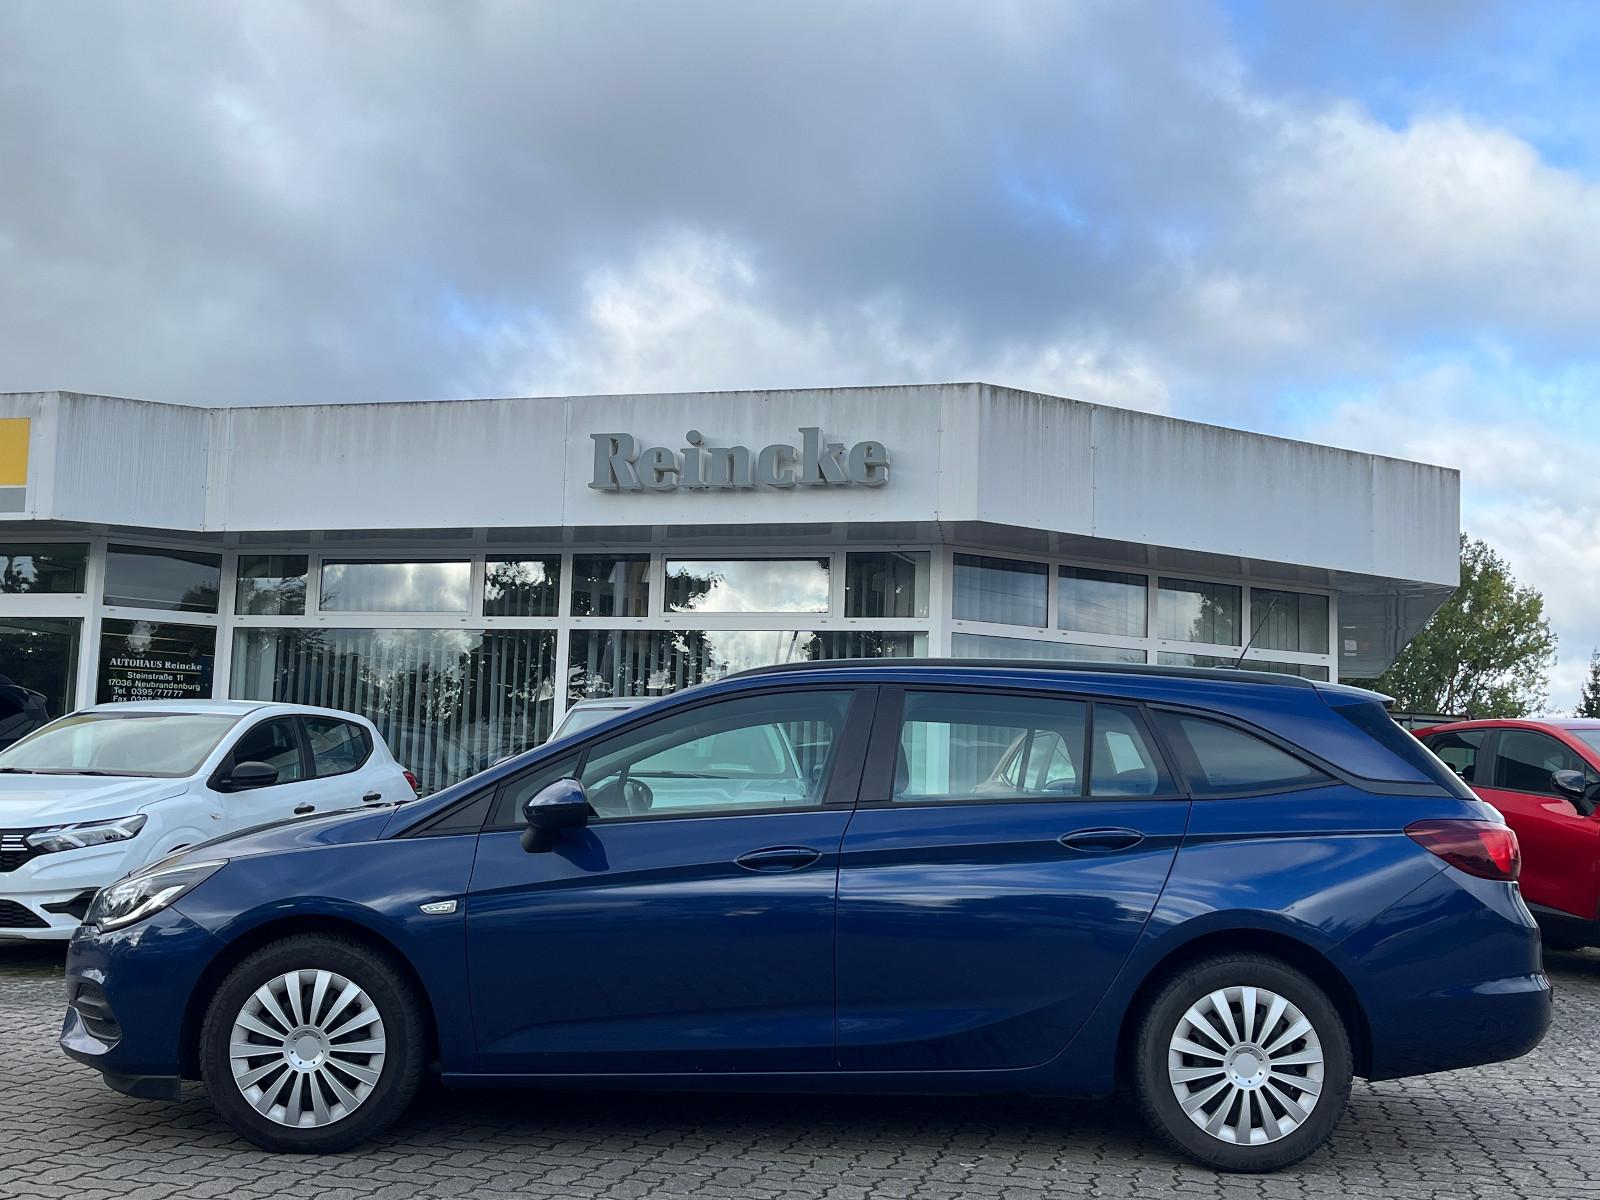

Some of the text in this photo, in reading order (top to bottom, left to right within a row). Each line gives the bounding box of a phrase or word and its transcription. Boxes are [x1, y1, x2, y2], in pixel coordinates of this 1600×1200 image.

[588, 427, 890, 491] Reincke
[109, 657, 202, 671] AUTOHAUS Reincke
[127, 671, 173, 681] Steinstraße
[108, 678, 201, 691] 17036 Neubrandenburg
[113, 686, 127, 695] Tel.
[112, 695, 127, 703] Fax
